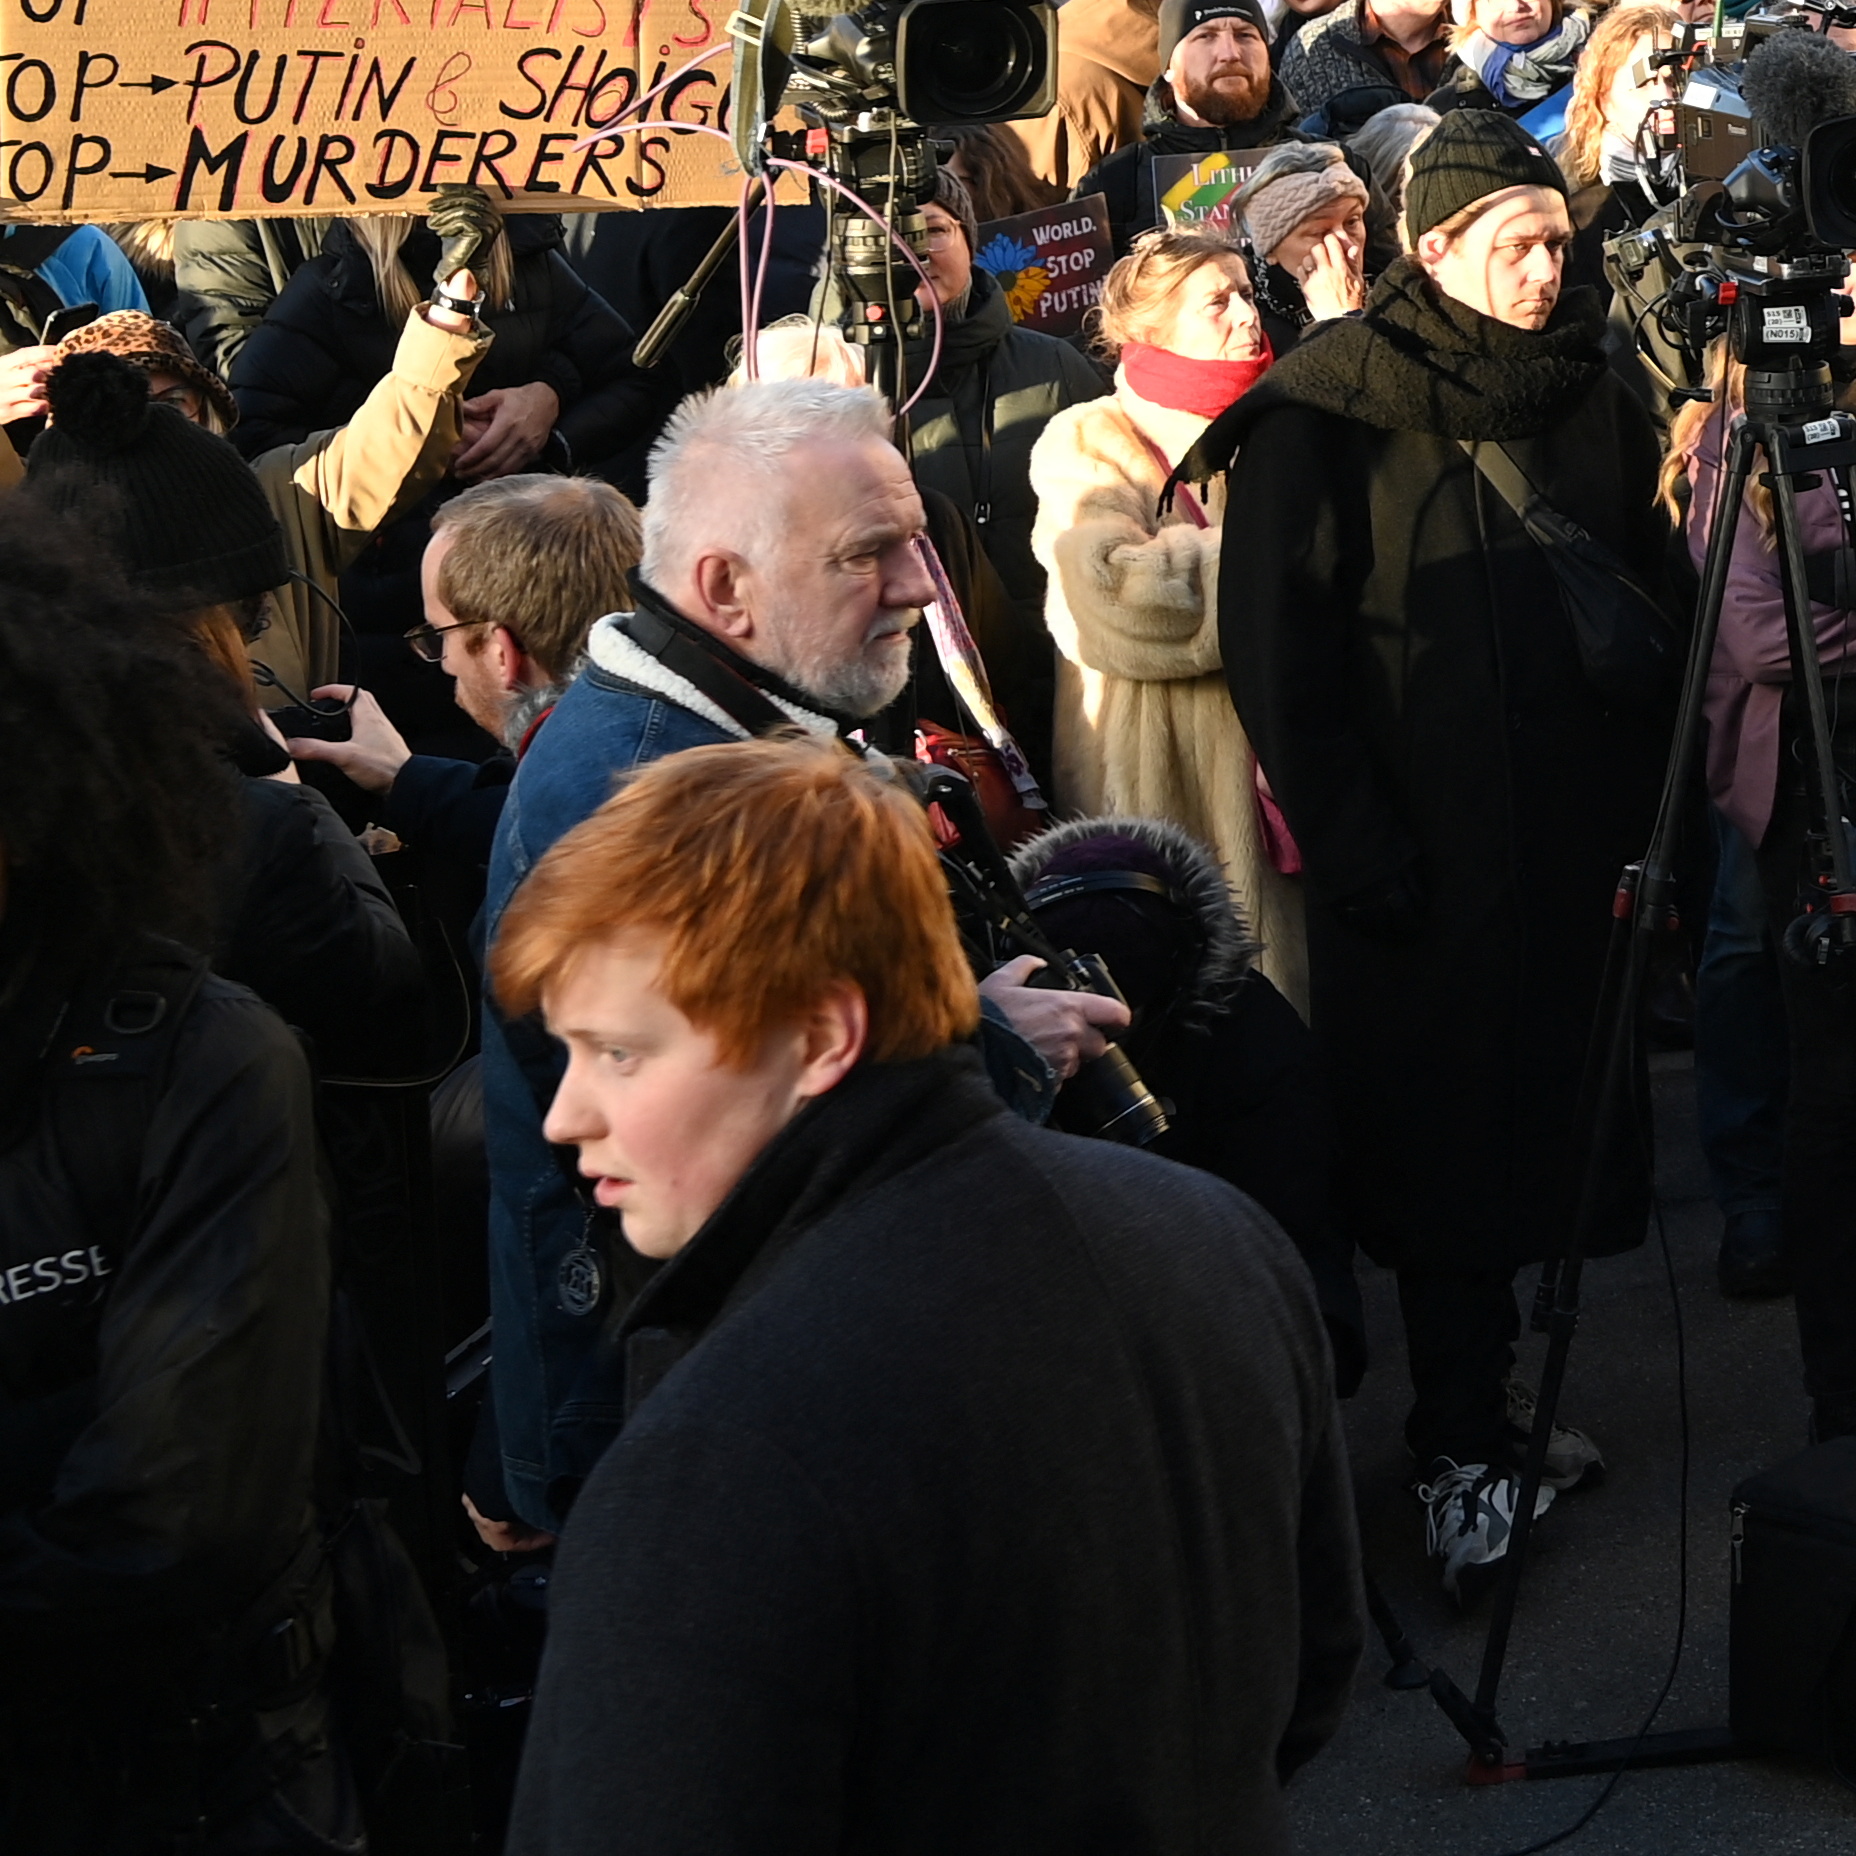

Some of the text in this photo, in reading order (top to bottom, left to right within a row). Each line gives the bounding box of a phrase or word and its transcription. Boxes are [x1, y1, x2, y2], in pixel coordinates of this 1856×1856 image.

[0, 50, 119, 123] OP
[0, 123, 671, 212] OP MURDERERS
[1046, 248, 1095, 278] STOP
